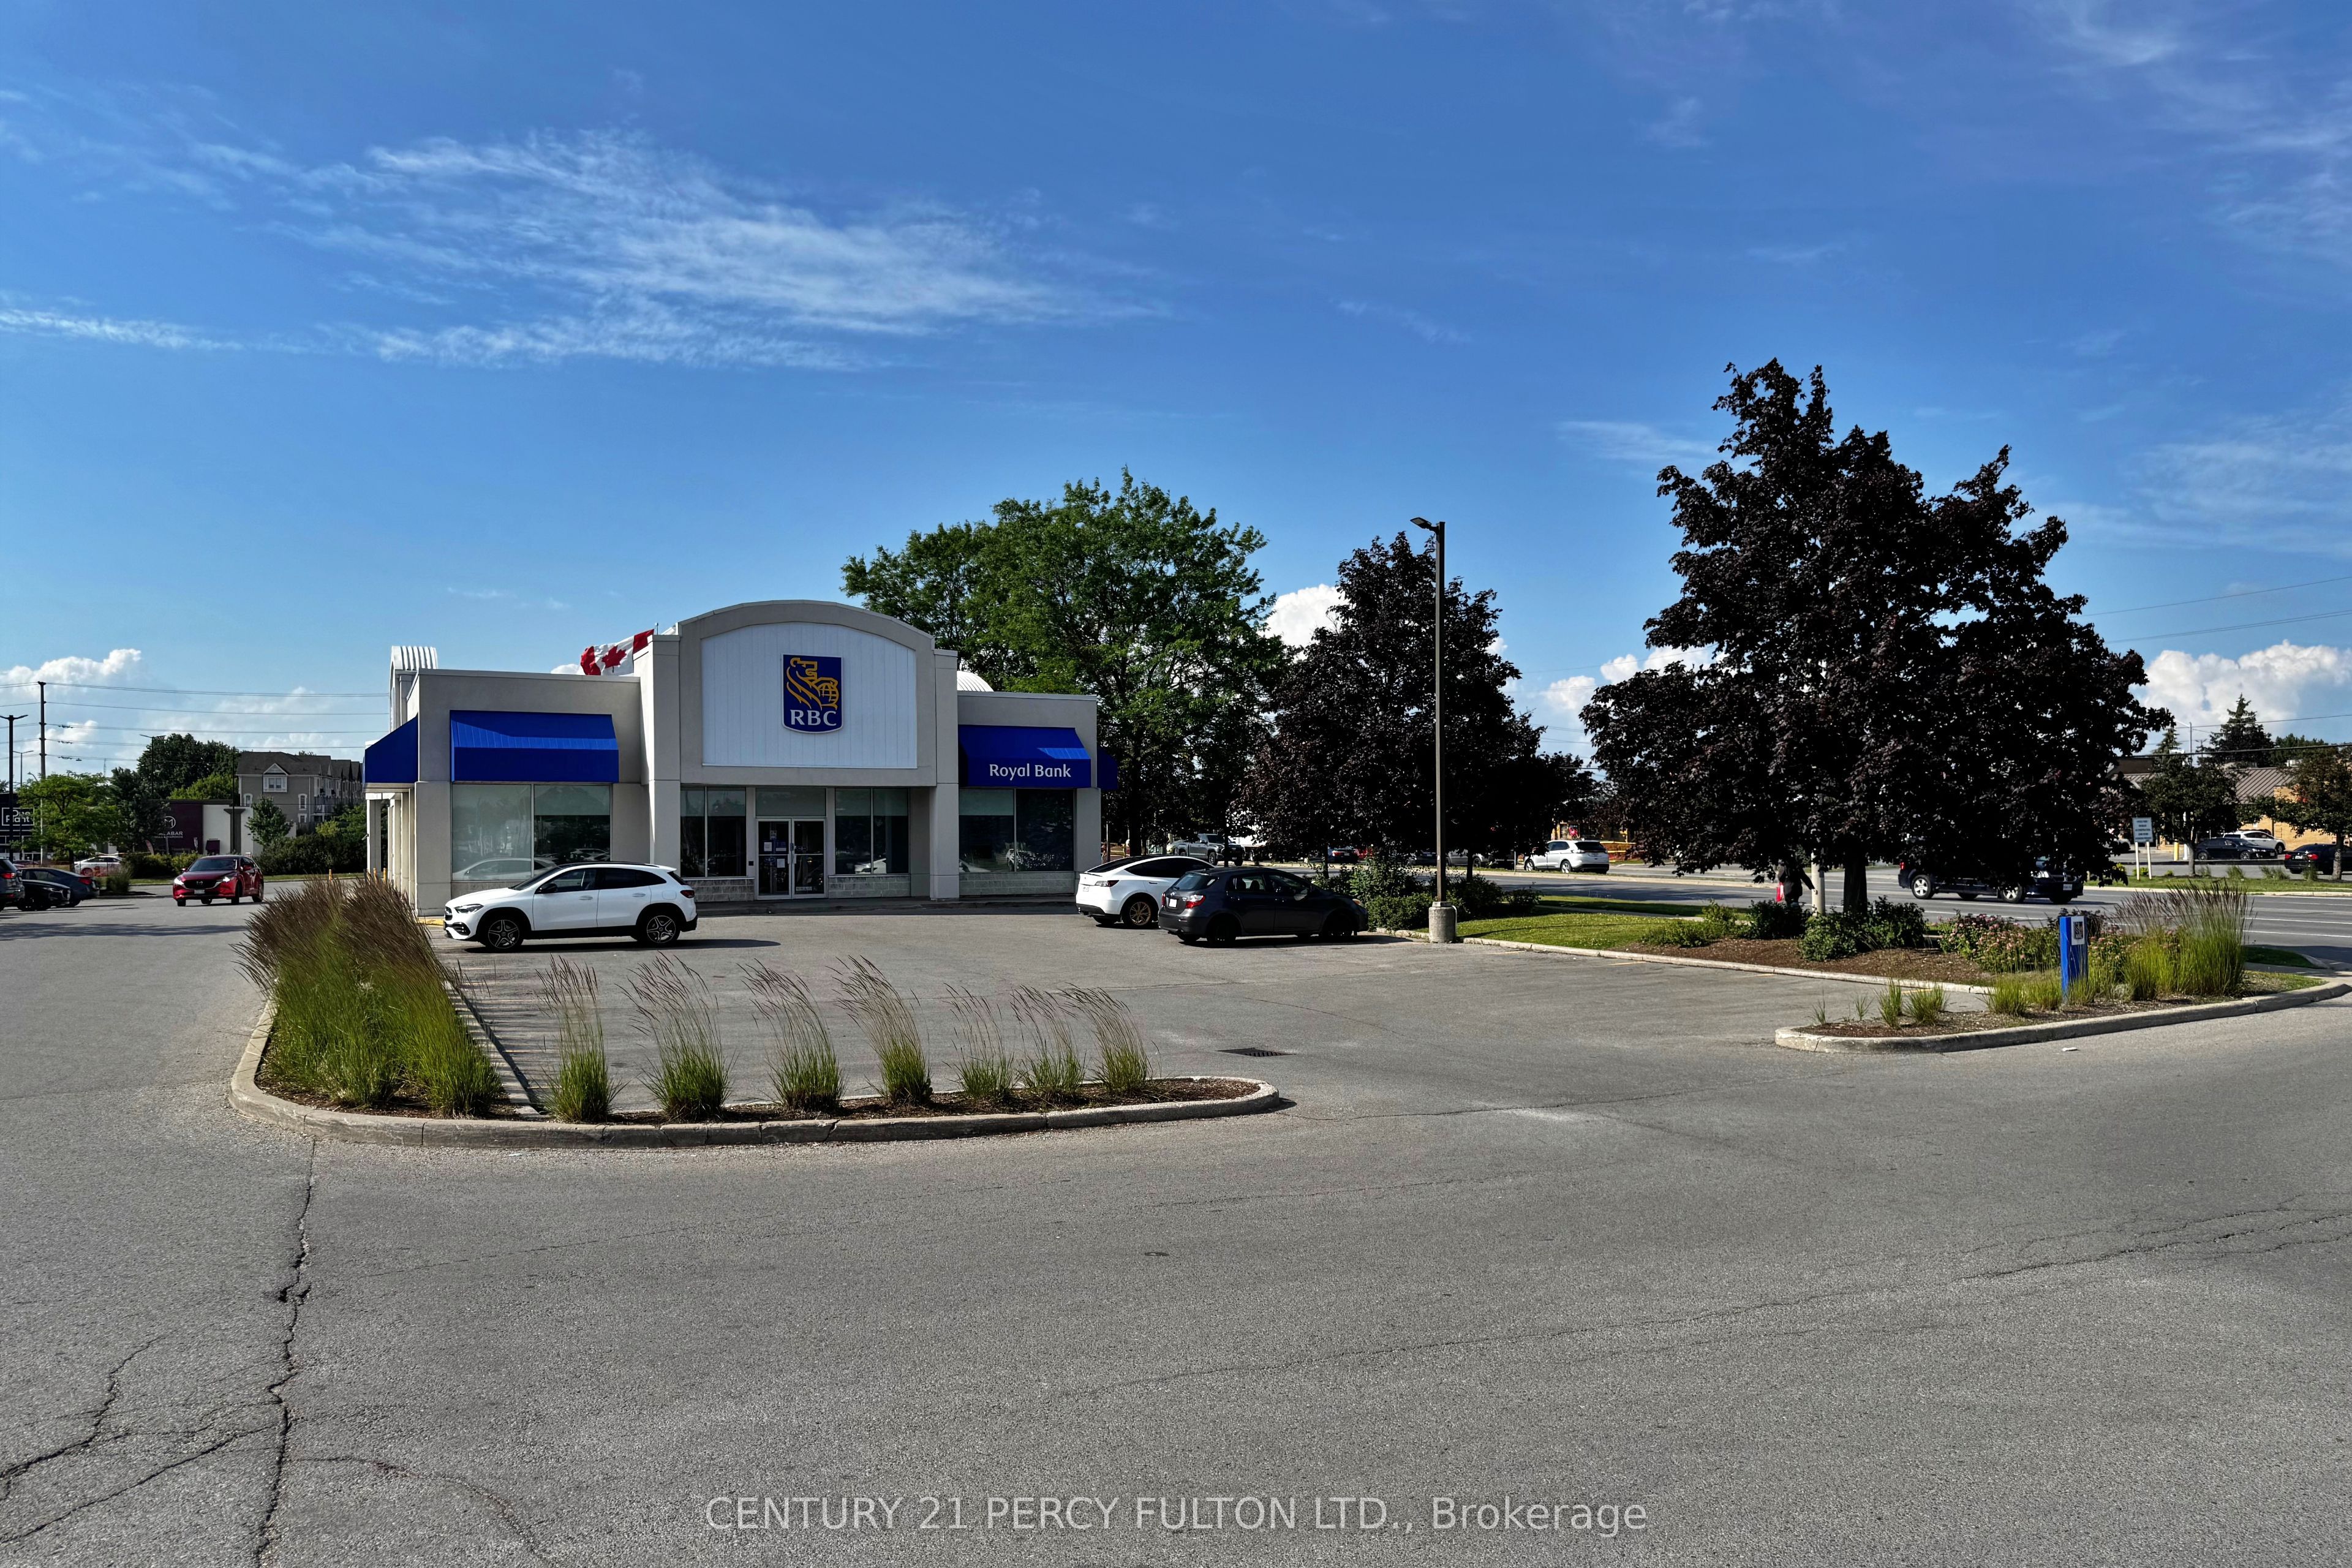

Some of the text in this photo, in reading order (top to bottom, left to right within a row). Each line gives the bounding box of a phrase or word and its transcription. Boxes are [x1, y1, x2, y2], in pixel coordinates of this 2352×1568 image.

[790, 709, 837, 726] RBC
[989, 763, 1071, 781] Royal Bank
